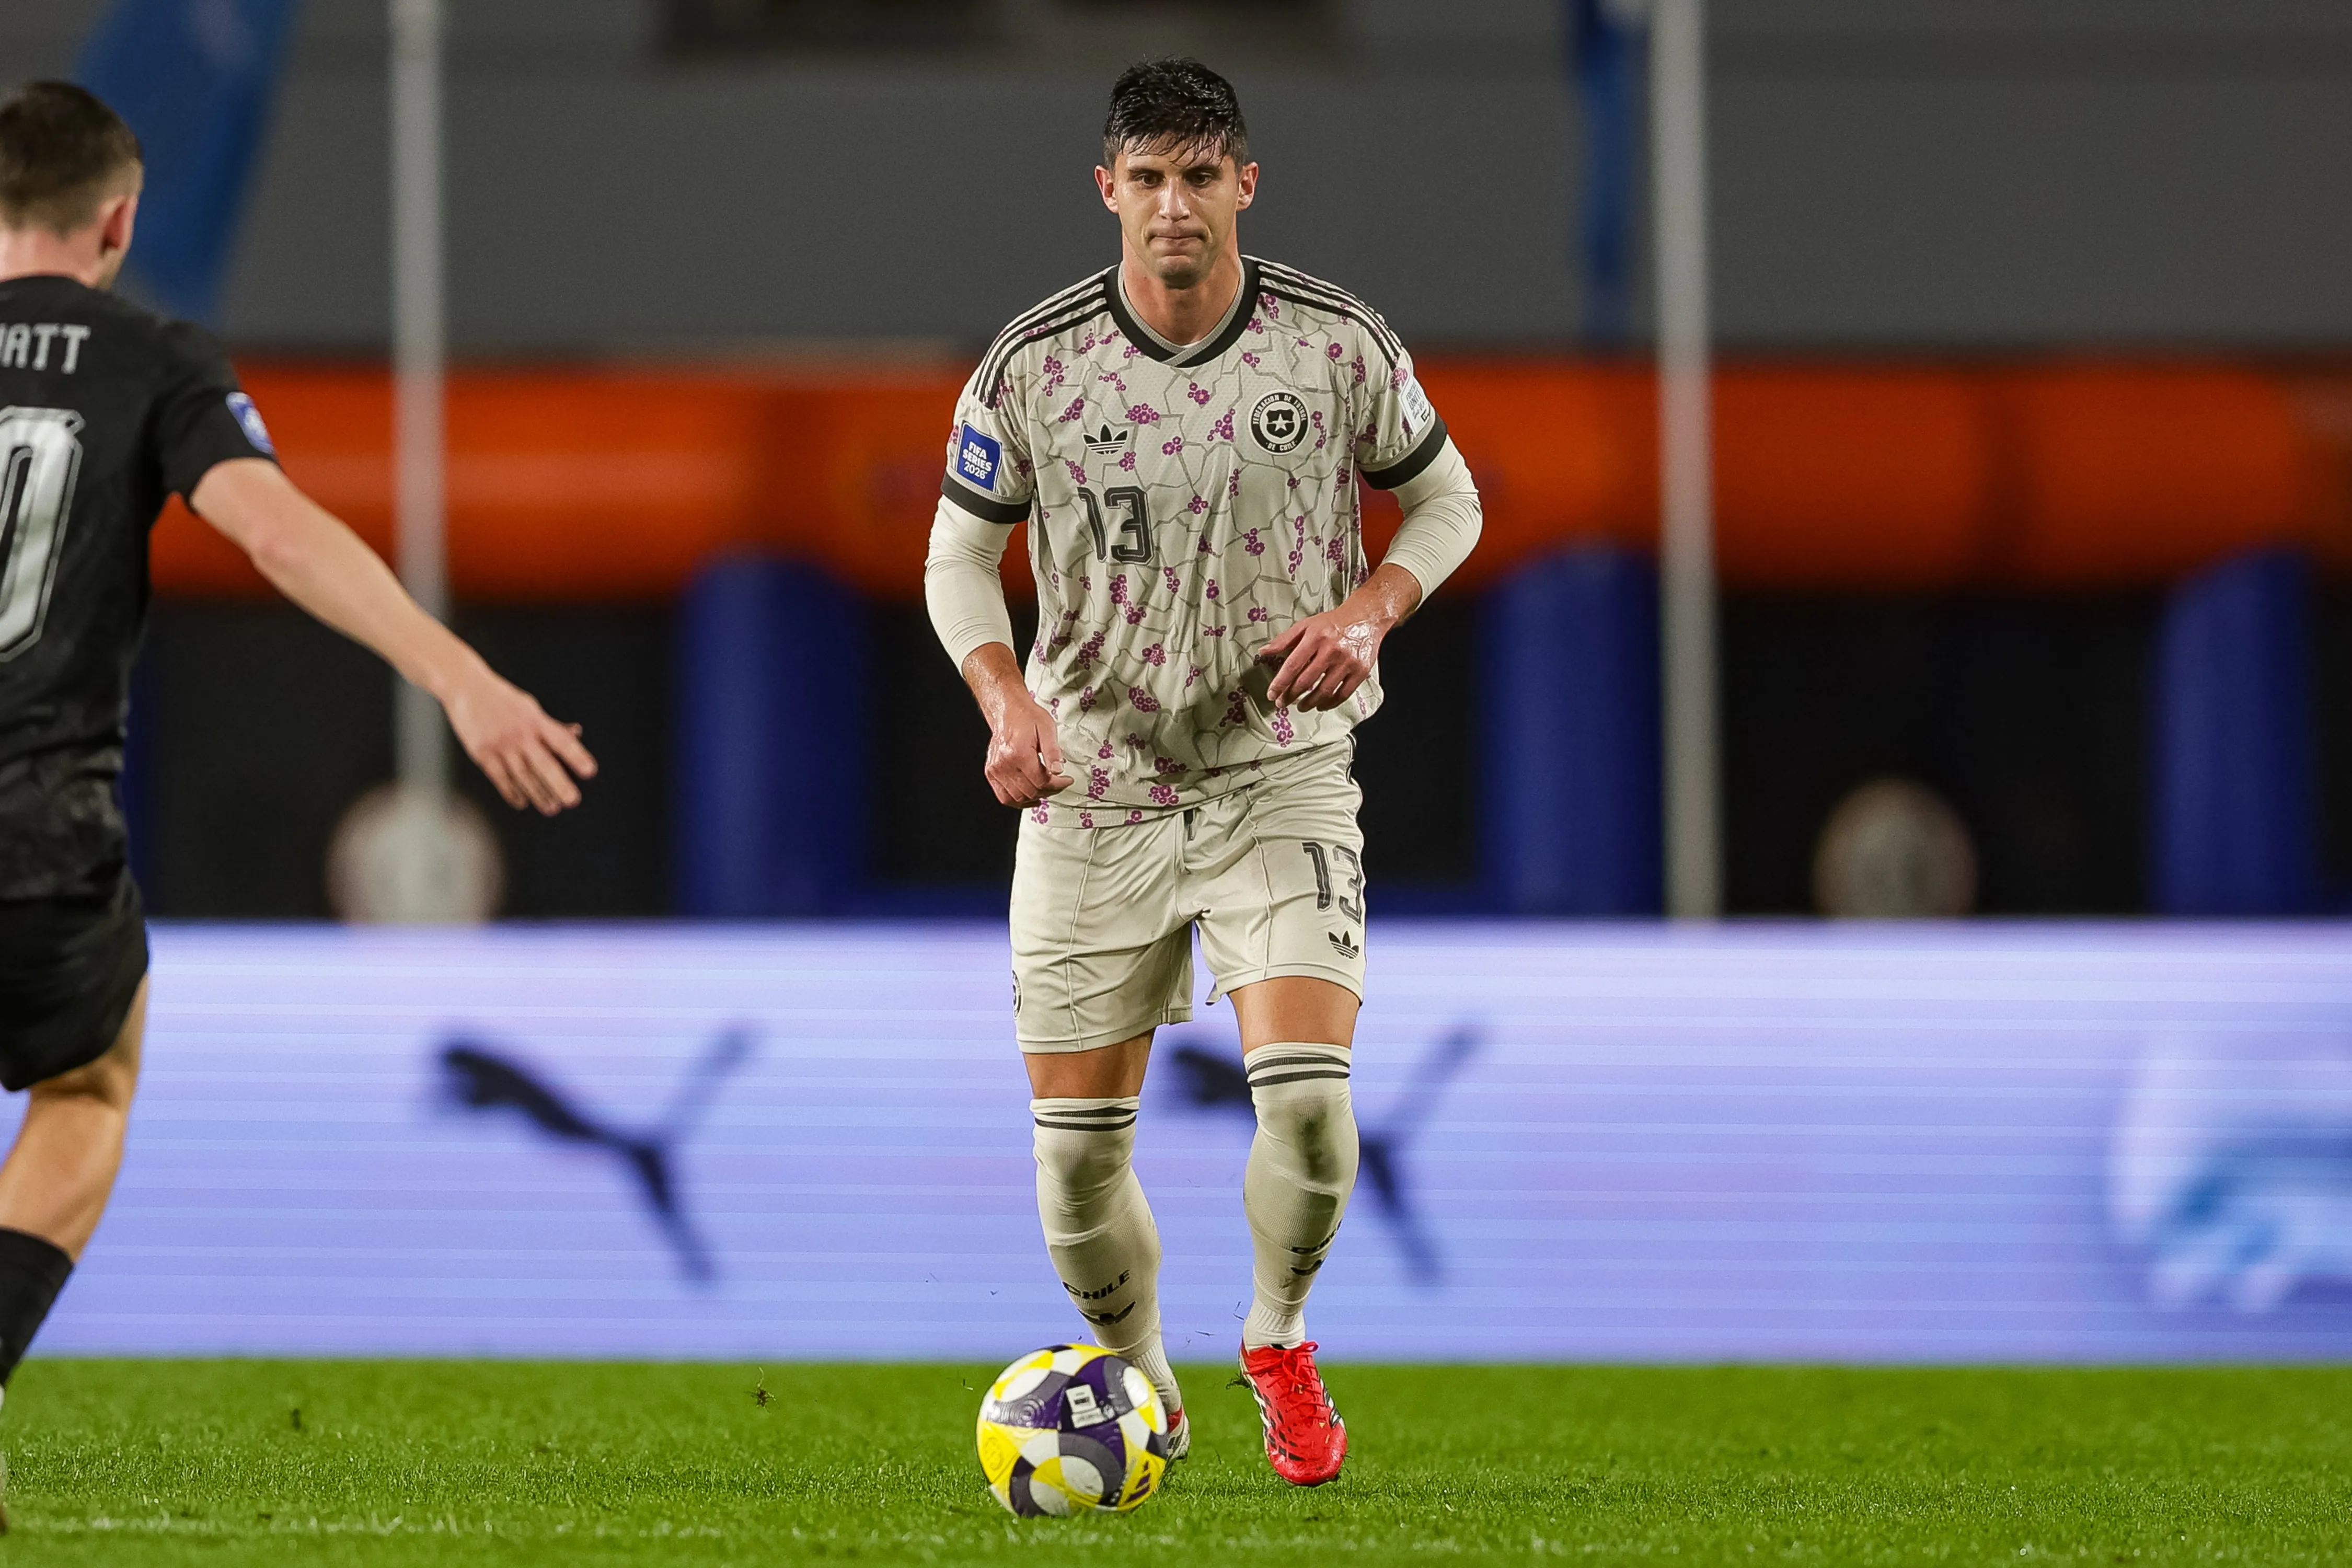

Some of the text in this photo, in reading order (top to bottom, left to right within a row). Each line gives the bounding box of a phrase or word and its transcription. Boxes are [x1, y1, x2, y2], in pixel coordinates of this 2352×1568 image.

[962, 448, 992, 471] SERIES
[969, 441, 987, 459] FIFA
[964, 461, 986, 480] 2026
[1077, 486, 1154, 566] 13
[1301, 841, 1363, 928] 13
[1063, 1269, 1131, 1300] CHILE
